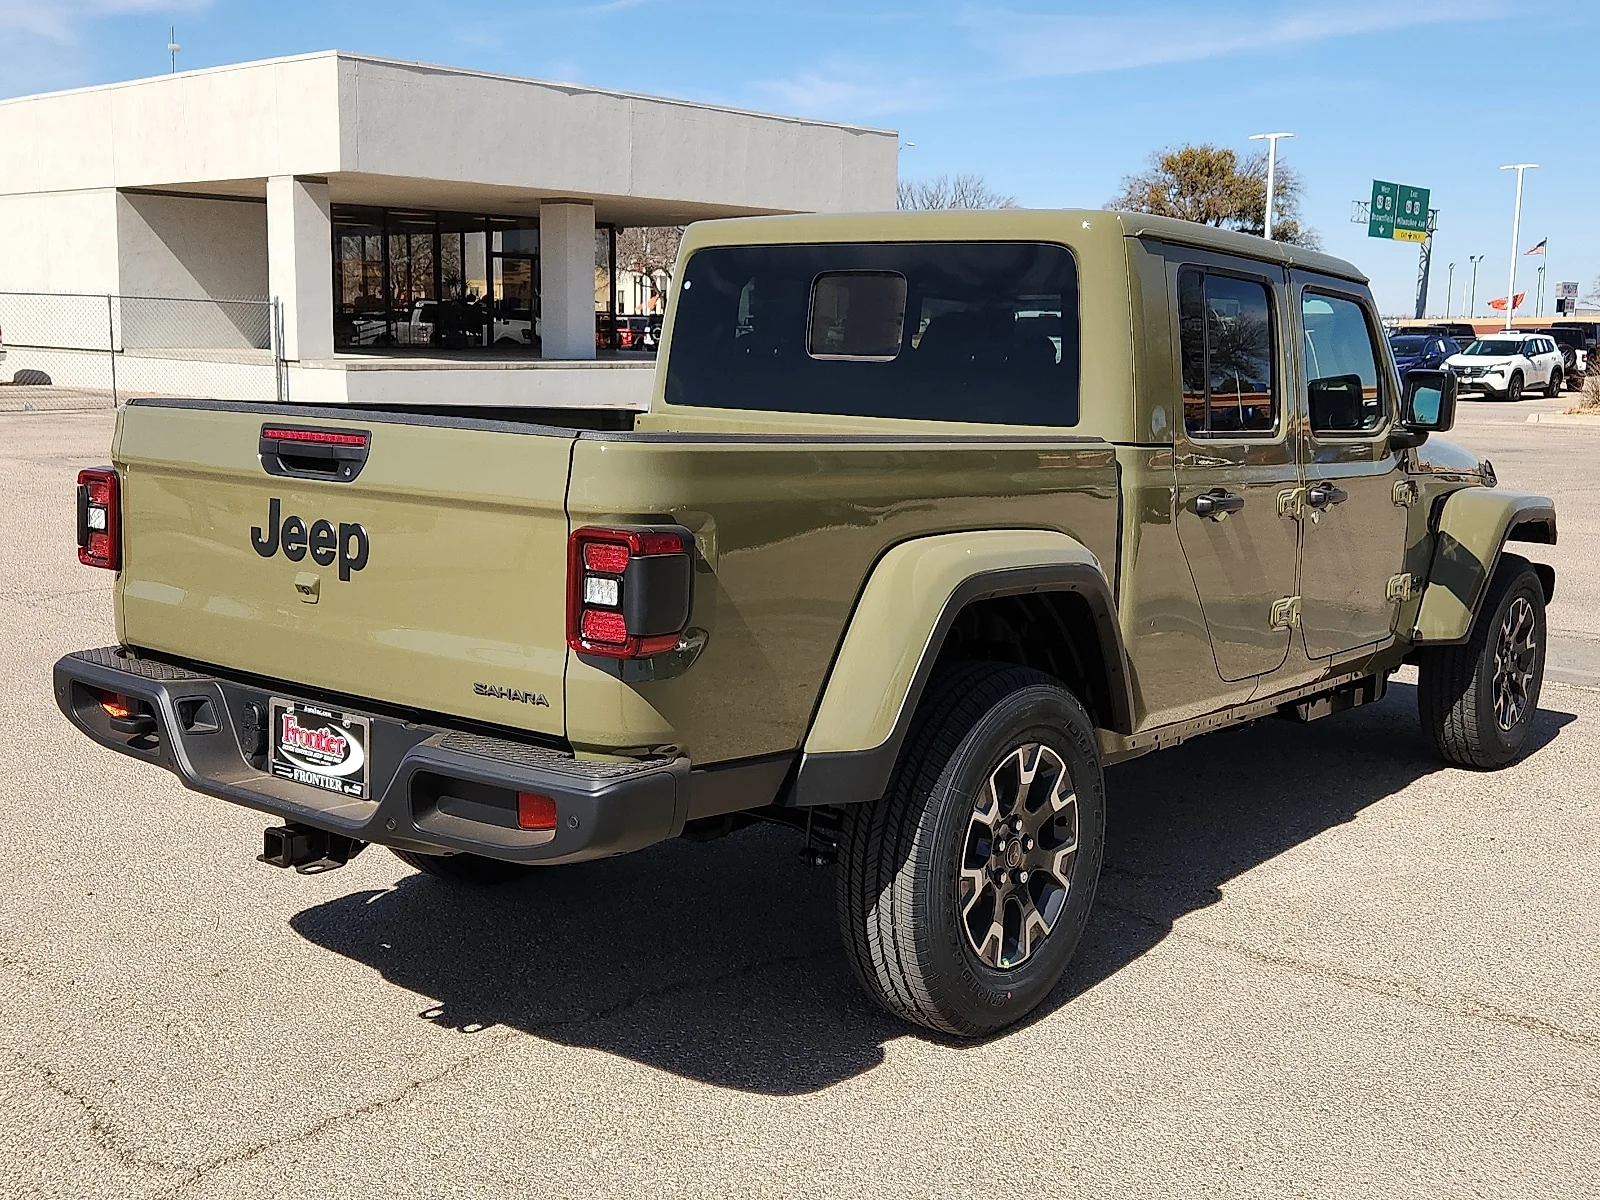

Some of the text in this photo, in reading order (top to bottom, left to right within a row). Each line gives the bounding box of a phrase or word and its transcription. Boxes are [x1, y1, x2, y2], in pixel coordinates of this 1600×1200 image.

[251, 498, 369, 582] Jeep
[473, 682, 550, 708] SAHARA
[282, 714, 345, 758] Frontier
[293, 768, 343, 792] FRONTIER
